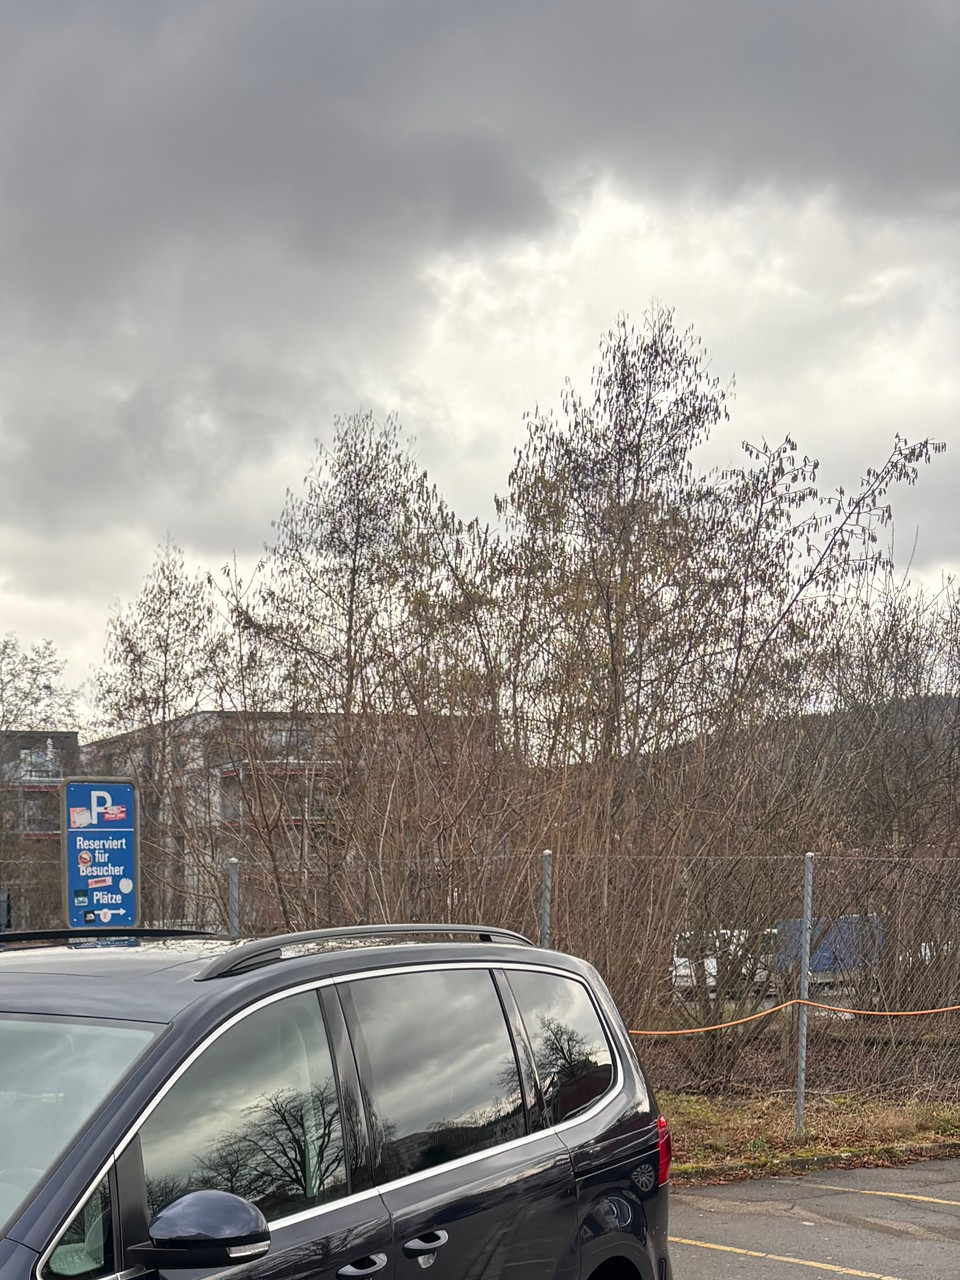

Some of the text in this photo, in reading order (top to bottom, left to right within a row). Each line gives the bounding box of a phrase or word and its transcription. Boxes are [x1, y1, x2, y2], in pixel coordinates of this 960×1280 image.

[91, 790, 113, 825] P
[76, 836, 127, 849] Reserviert
[94, 850, 110, 863] für
[78, 863, 124, 876] Besucher
[93, 891, 122, 904] Plätze
